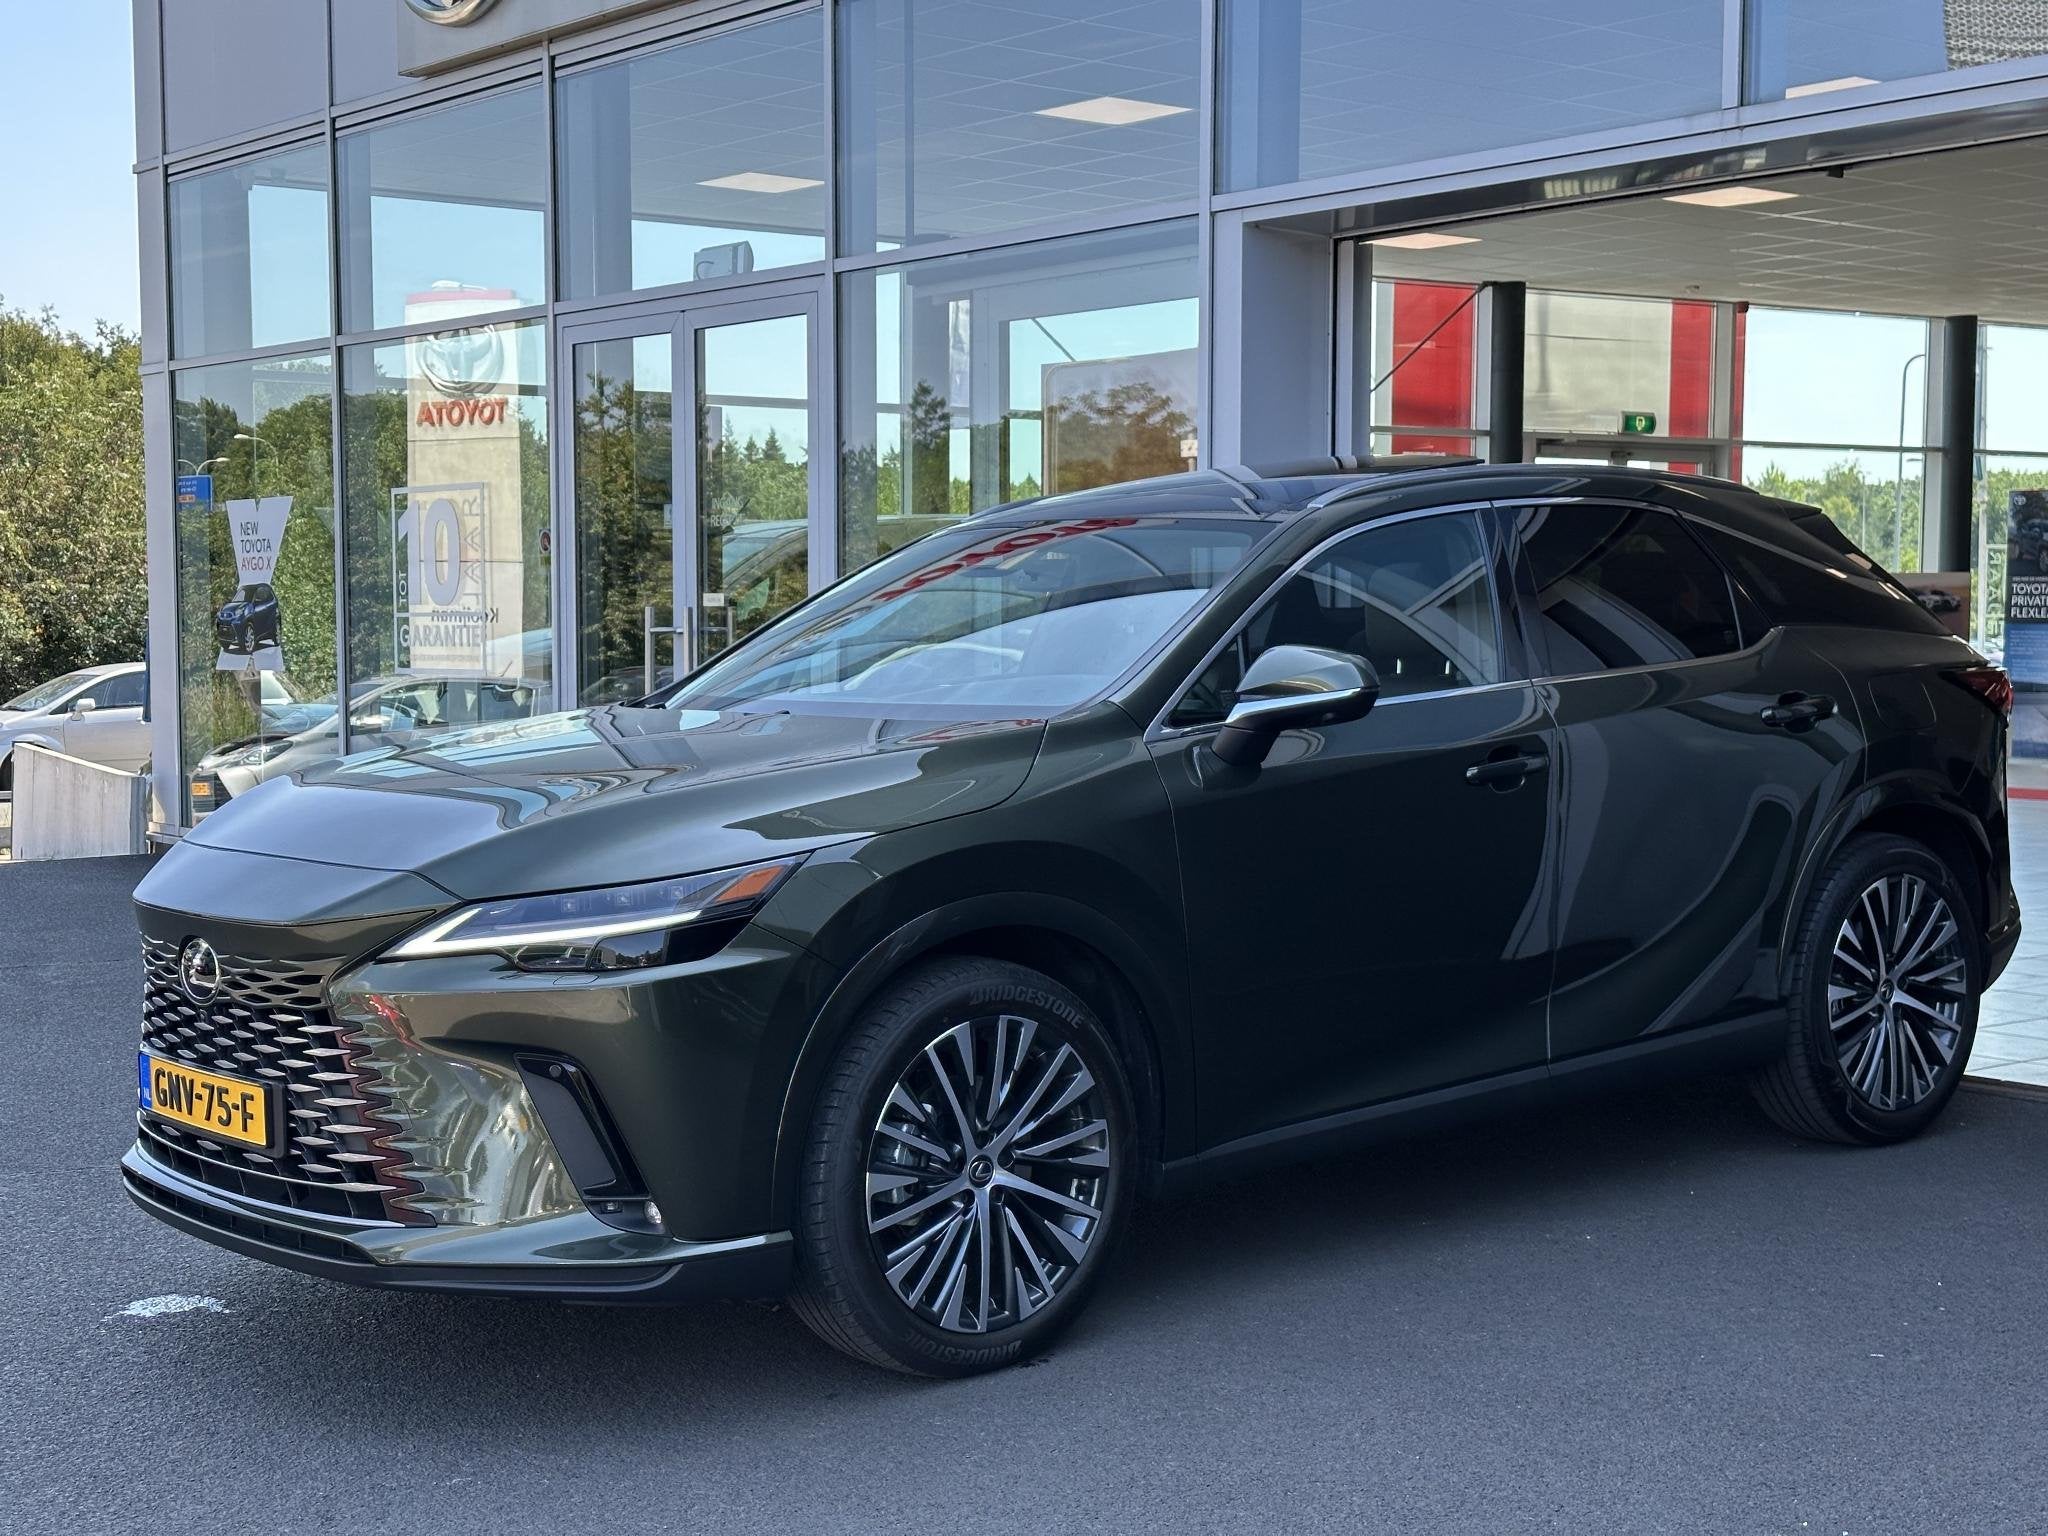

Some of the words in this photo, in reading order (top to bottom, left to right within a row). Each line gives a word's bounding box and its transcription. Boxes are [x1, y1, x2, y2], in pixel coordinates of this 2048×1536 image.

[240, 521, 259, 536] NEW
[240, 538, 272, 553] TOYOTA
[397, 498, 461, 606] 10
[241, 556, 264, 571] AYGO
[265, 556, 272, 570] X
[399, 570, 407, 606] TOT
[2010, 607, 2048, 618] FLEXLE
[400, 624, 482, 648] GARANTIE
[968, 984, 1085, 1030] BRIDGESTONE
[154, 1067, 254, 1133] GNV-75-F
